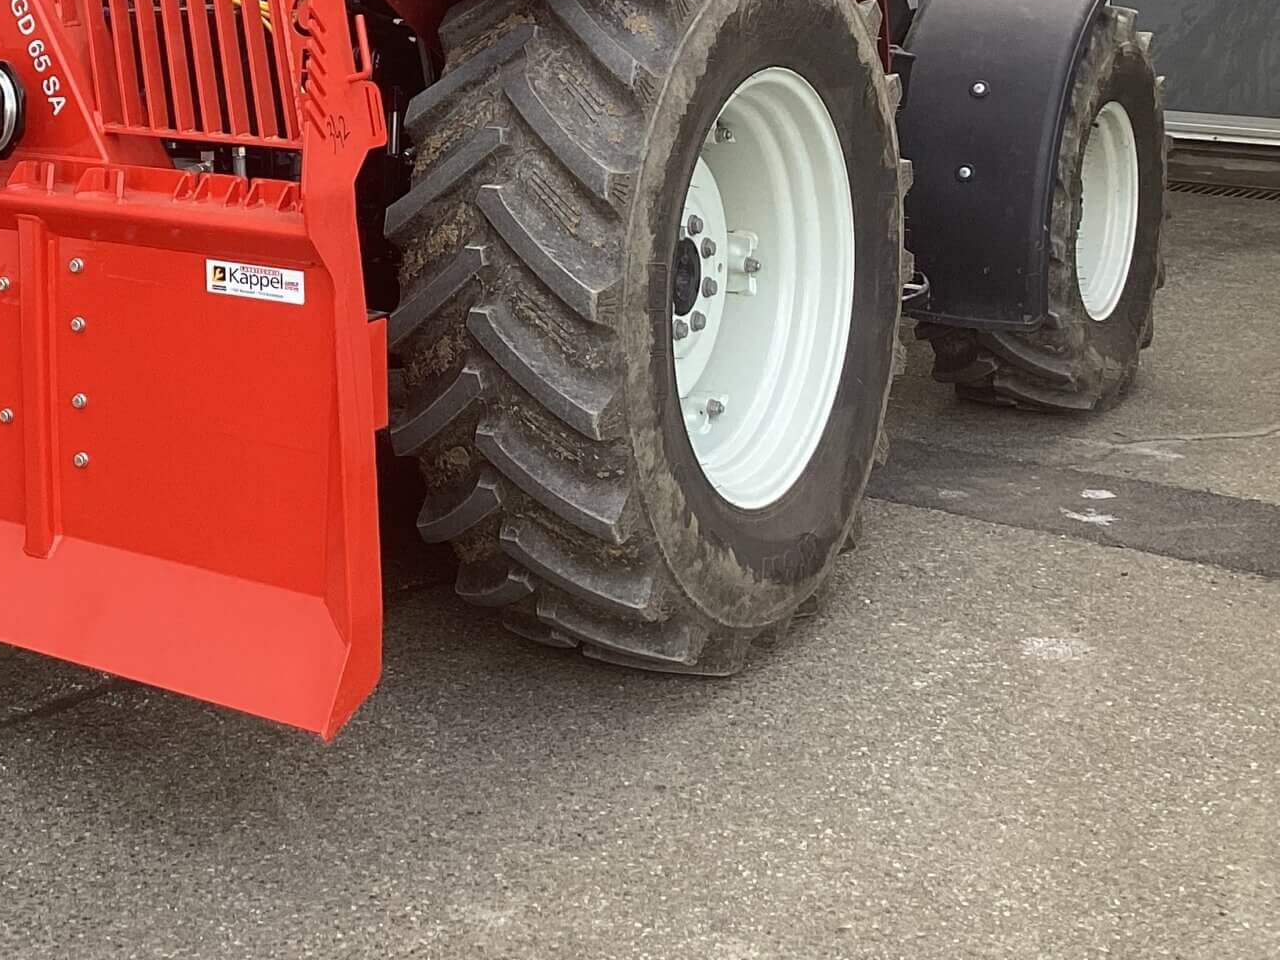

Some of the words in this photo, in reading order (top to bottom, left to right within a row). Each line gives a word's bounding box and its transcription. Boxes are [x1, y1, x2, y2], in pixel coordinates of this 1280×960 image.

[28, 39, 52, 73] 65
[42, 75, 68, 116] SA
[228, 266, 284, 291] Kappel
